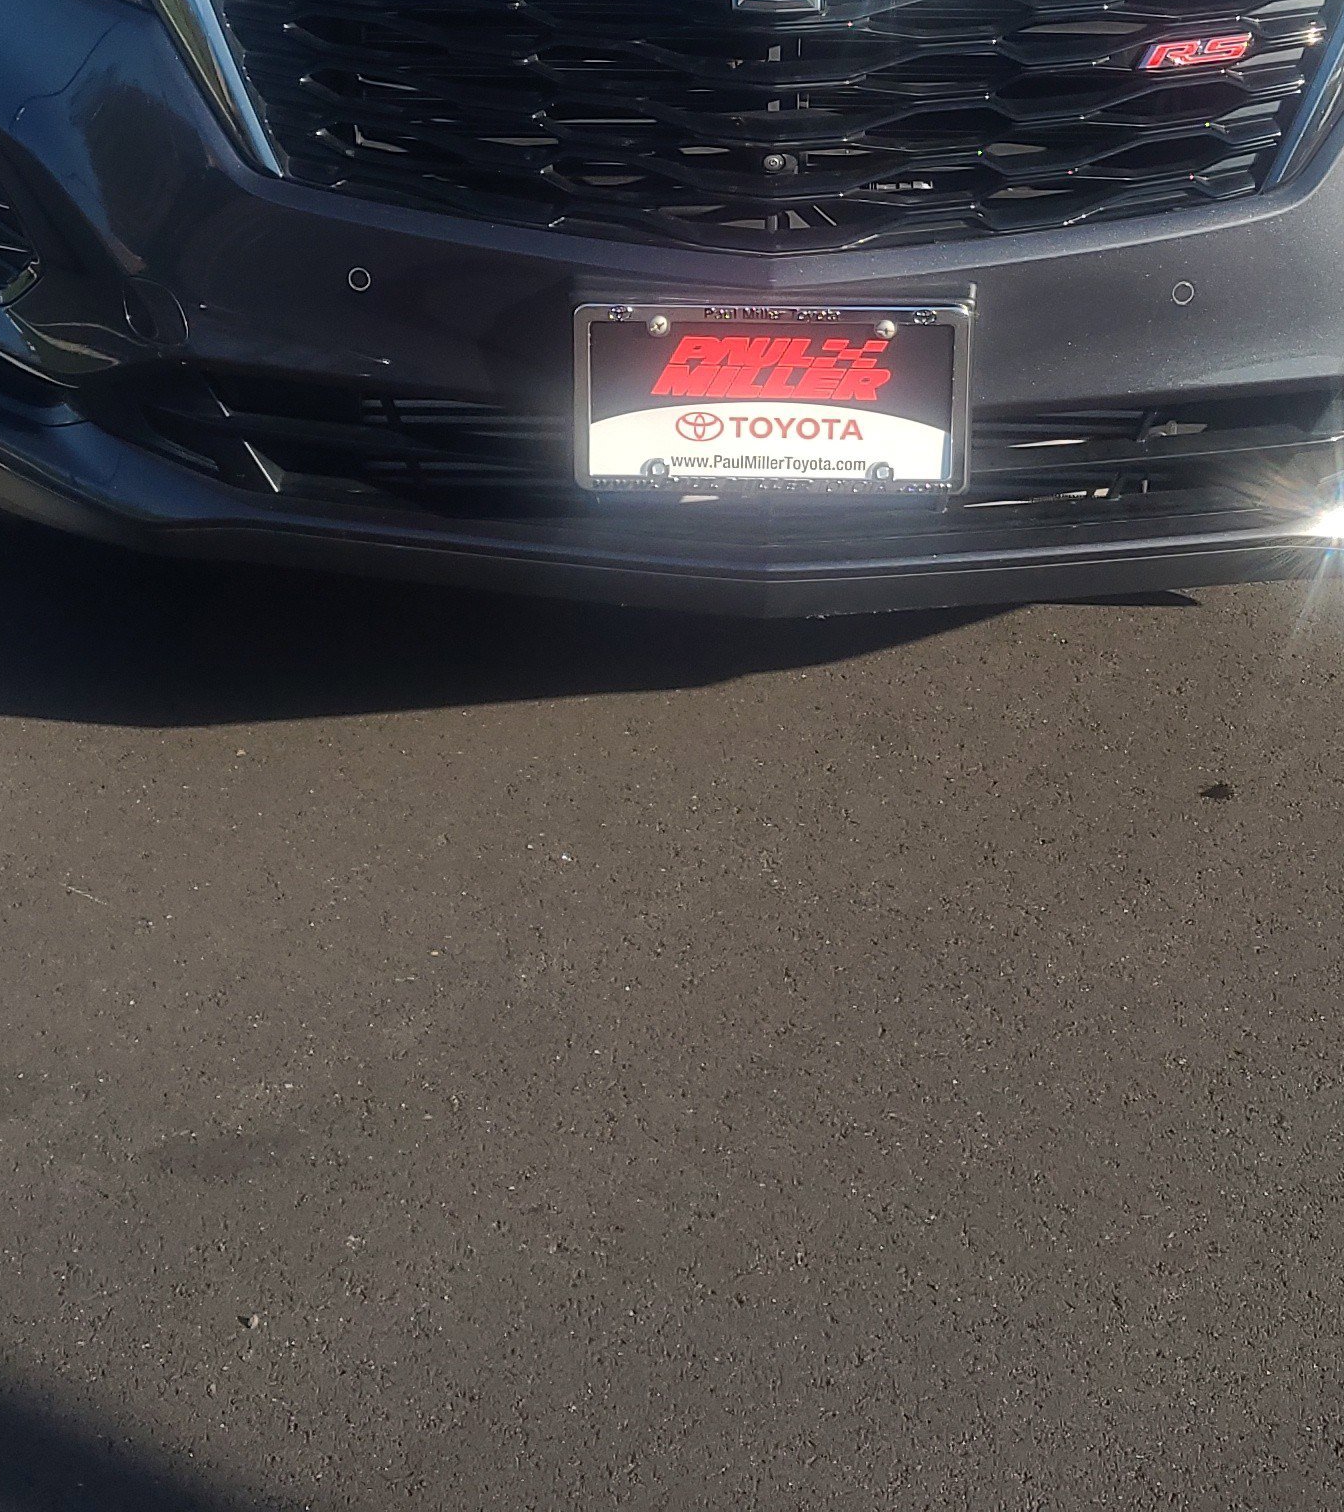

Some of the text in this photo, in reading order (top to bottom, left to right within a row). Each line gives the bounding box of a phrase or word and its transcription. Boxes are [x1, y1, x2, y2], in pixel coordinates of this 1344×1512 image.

[1138, 31, 1253, 69] RS
[704, 307, 737, 320] Paul
[669, 335, 815, 368] PAUL
[650, 364, 892, 400] MILLER
[728, 416, 864, 441] TOYOTA
[670, 454, 867, 474] www.PaulMillerToyota.com
